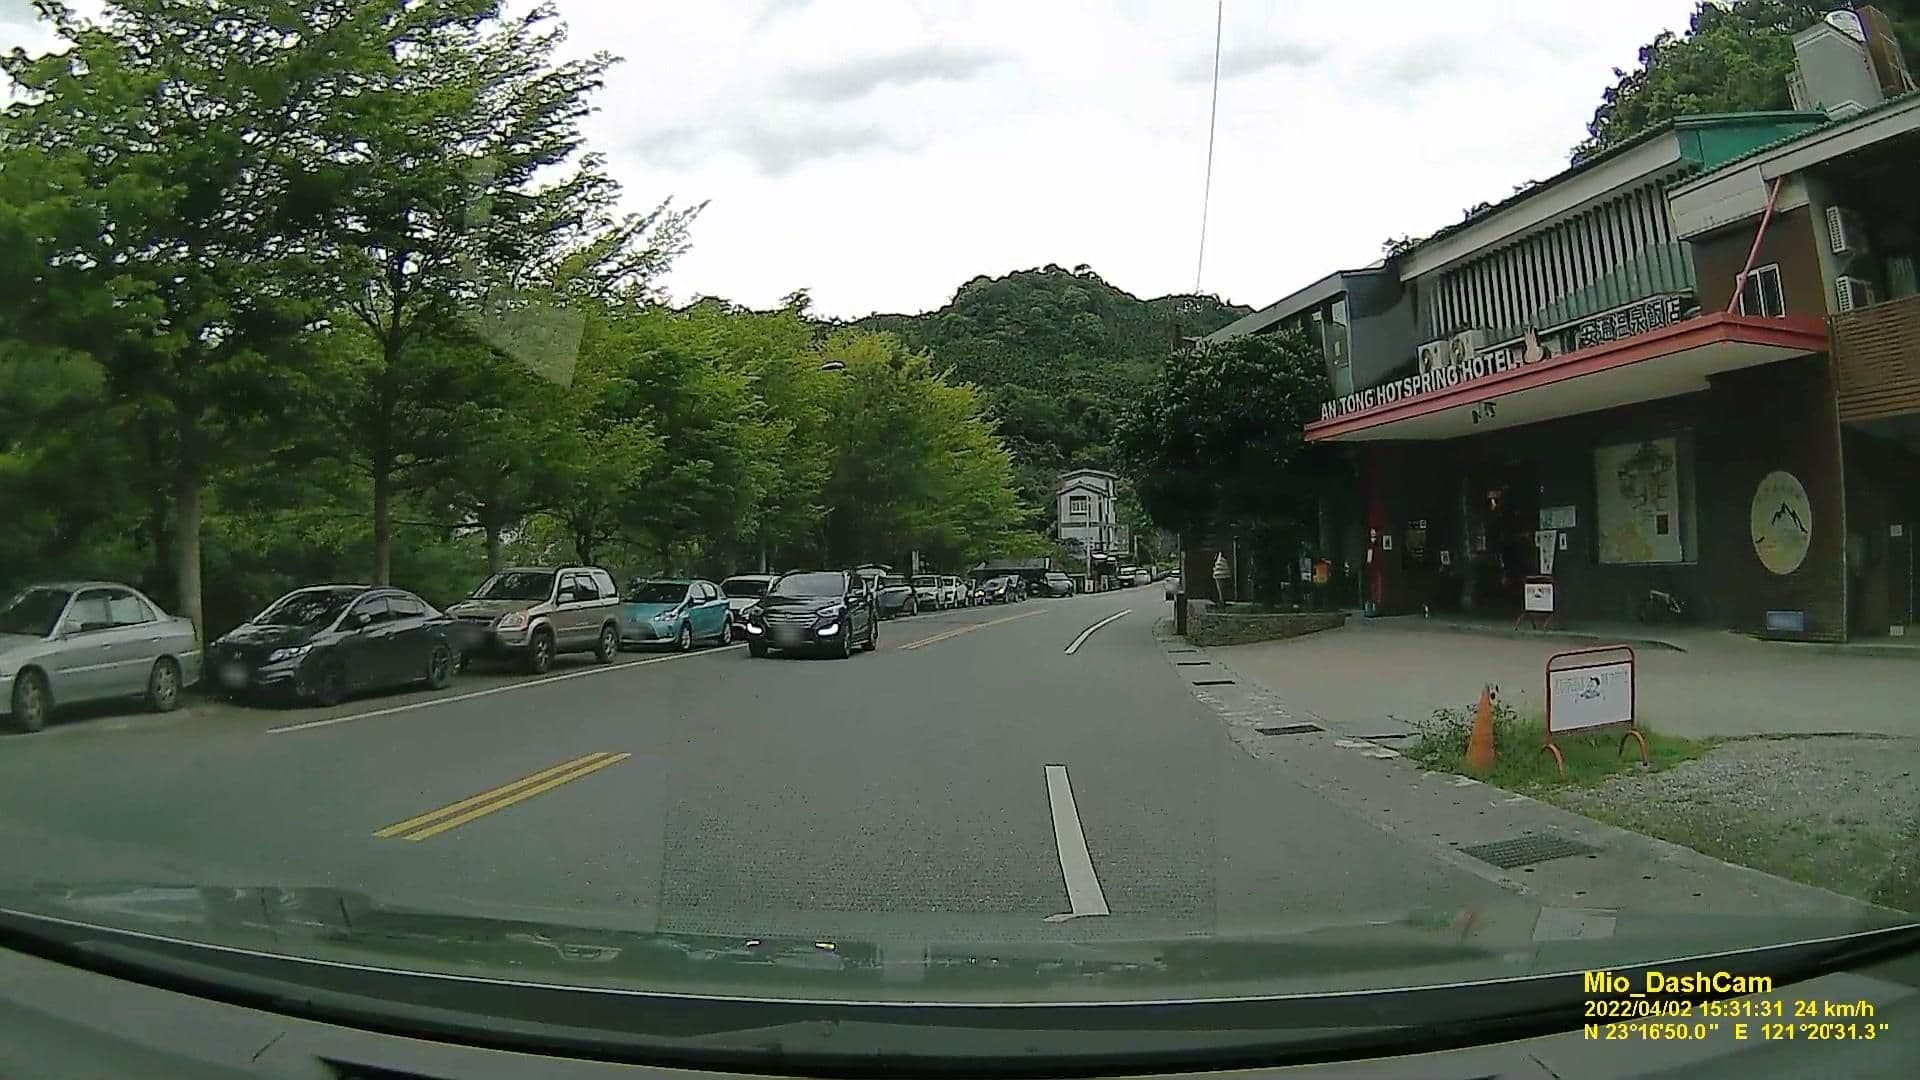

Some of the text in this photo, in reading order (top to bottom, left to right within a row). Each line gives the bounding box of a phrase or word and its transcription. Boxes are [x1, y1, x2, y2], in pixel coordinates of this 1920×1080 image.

[1320, 402, 1337, 421] AN
[1339, 392, 1375, 416] TONG
[1461, 349, 1517, 381] HOTEL
